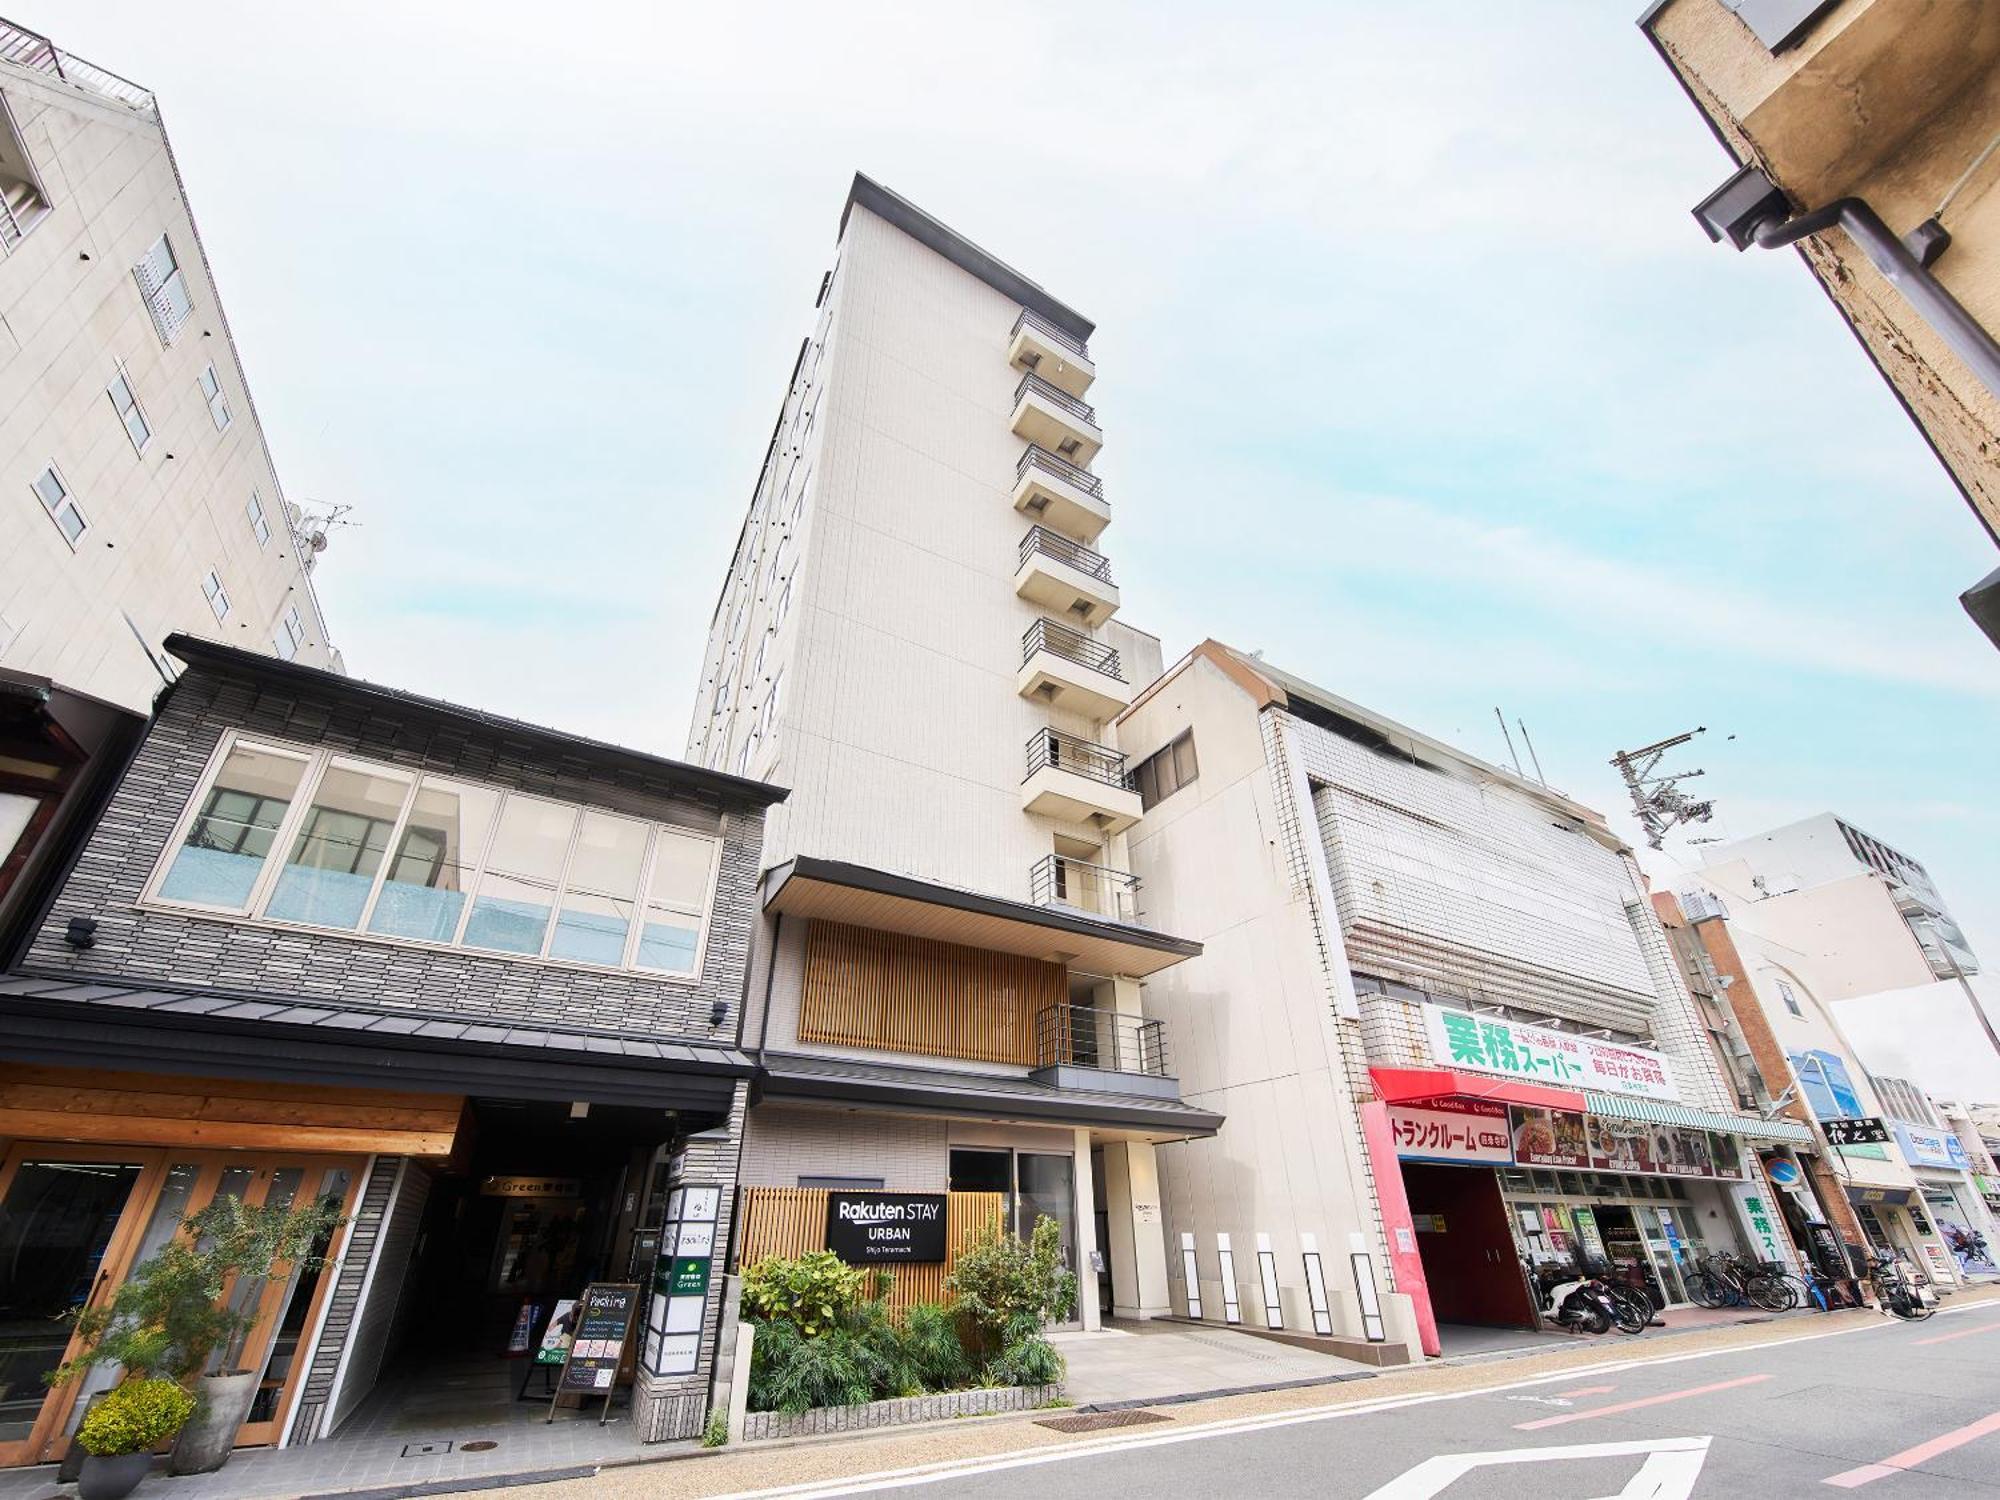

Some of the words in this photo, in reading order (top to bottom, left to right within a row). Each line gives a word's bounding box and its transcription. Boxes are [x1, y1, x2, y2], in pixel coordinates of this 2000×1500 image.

[1442, 1011, 1581, 1079] 業務スーパー
[1391, 1118, 1477, 1151] トランクルーム
[503, 1181, 542, 1191] Green
[840, 1201, 904, 1220] Rakuten
[906, 1204, 940, 1220] STAY
[868, 1228, 910, 1240] URBAN
[866, 1246, 881, 1255] Shijo
[677, 1281, 701, 1289] Green
